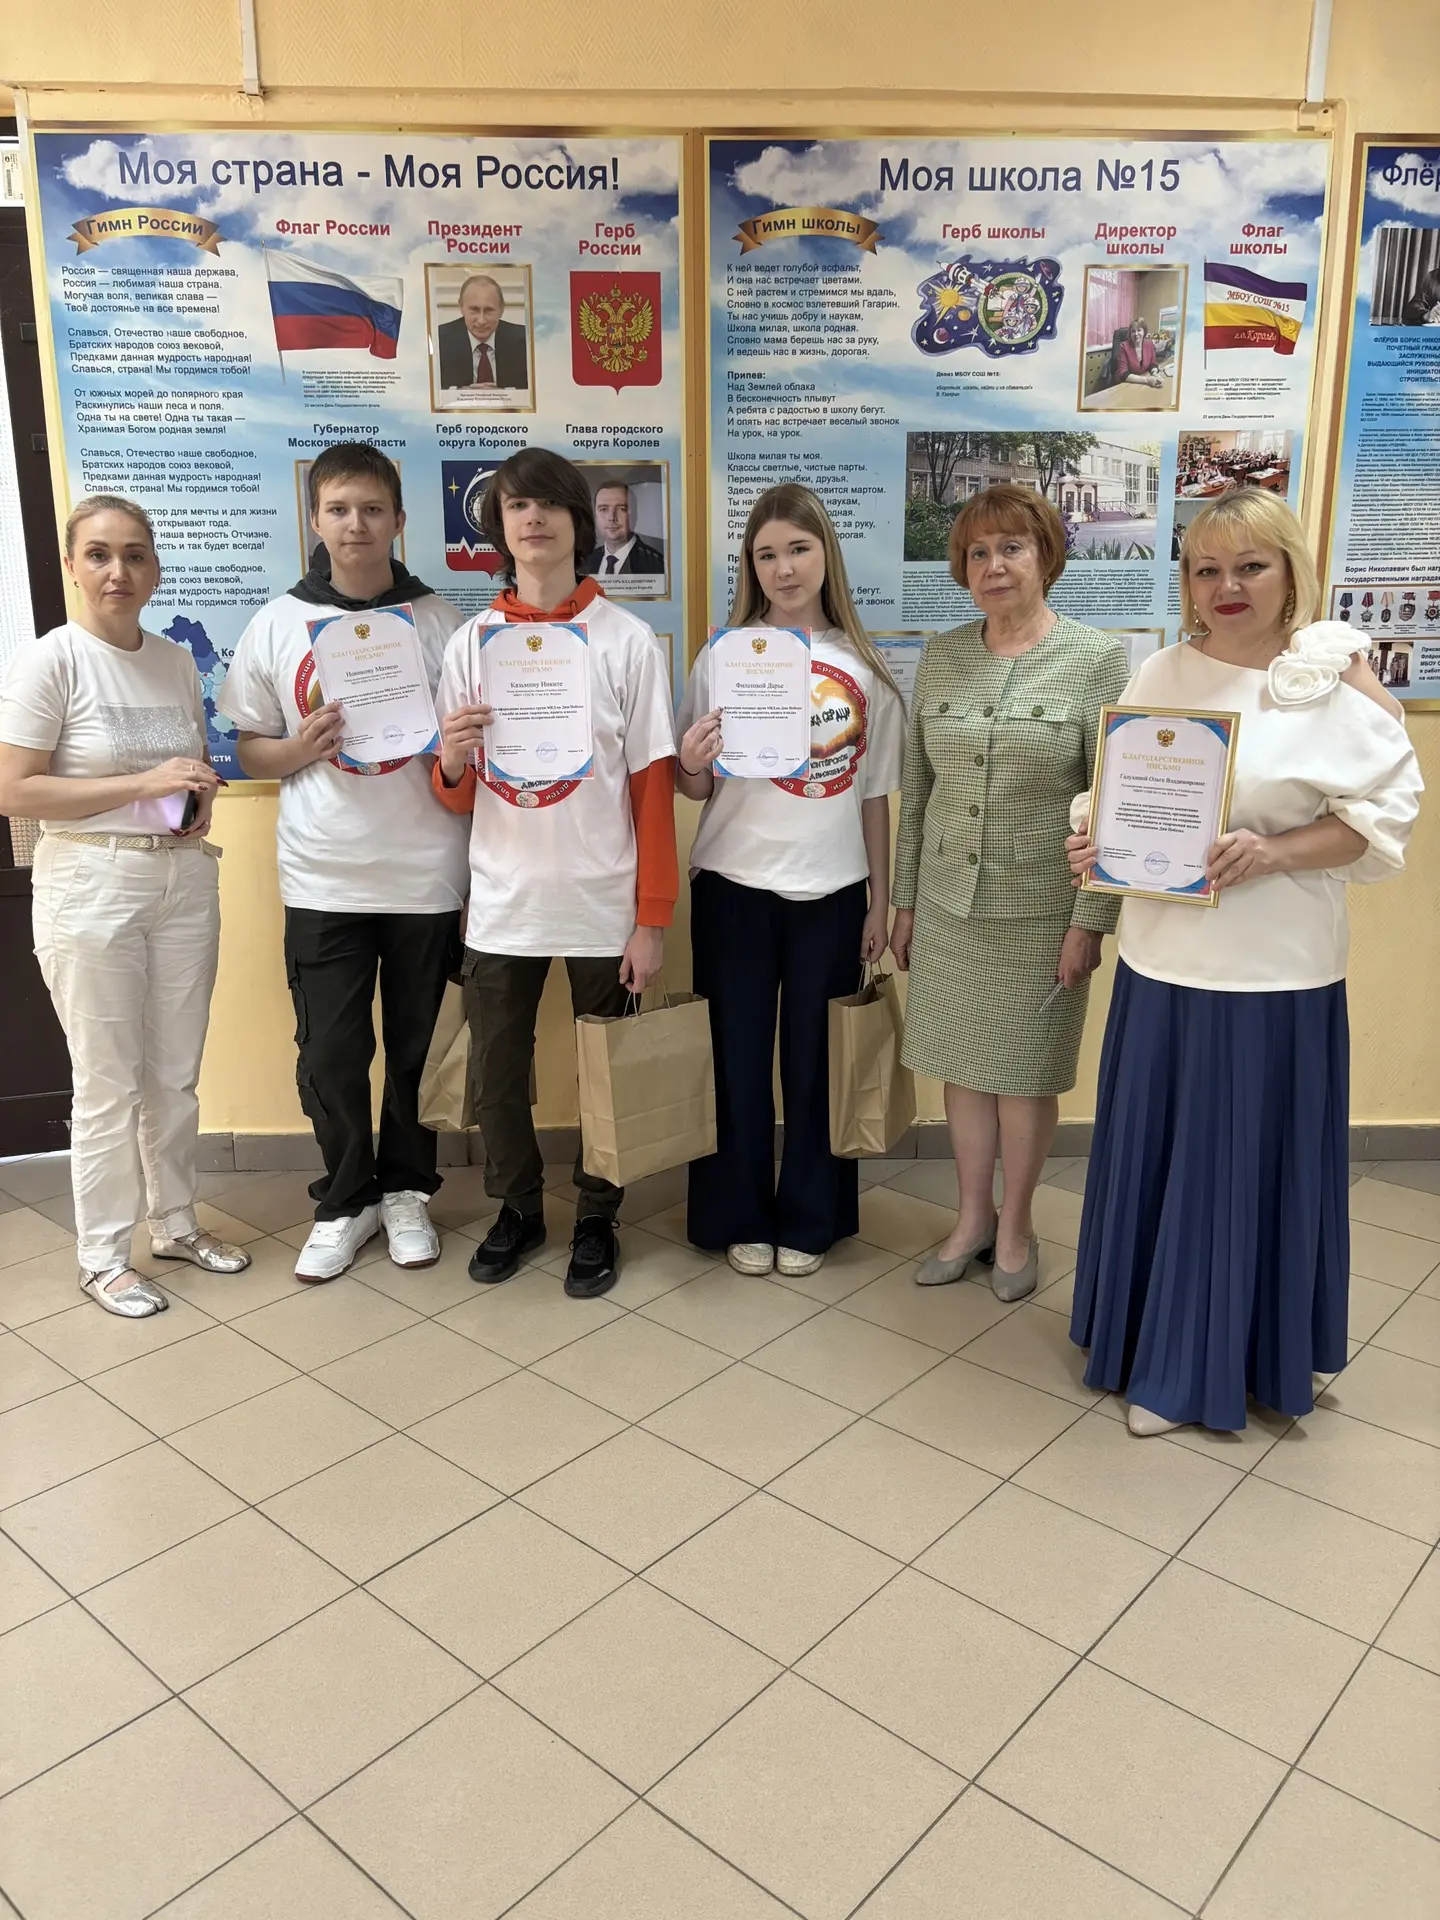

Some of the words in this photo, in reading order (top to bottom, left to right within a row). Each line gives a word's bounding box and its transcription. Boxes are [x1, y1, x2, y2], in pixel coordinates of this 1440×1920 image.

[118, 151, 197, 185] Моя
[211, 159, 344, 194] страна
[384, 154, 461, 189] Моя
[477, 154, 619, 191] Россия!
[879, 158, 954, 192] Моя
[968, 166, 1082, 192] школа
[1096, 158, 1181, 192] №15
[87, 215, 132, 237] Гимн
[138, 215, 203, 236] России
[276, 219, 321, 235] Флаг
[325, 219, 390, 236] России
[428, 220, 523, 239] Президент
[595, 222, 635, 241] Герб
[752, 218, 796, 235] Гимн
[802, 220, 861, 235] школы
[942, 223, 982, 242] Герб
[987, 227, 1045, 239] школы
[1094, 222, 1177, 240] Директор
[1241, 223, 1284, 238] Флаг
[446, 238, 510, 254] России
[579, 240, 641, 256] России
[1106, 243, 1164, 255] школы
[1230, 243, 1287, 255] школы
[61, 265, 96, 275] Россия
[111, 268, 164, 277] священная
[166, 268, 192, 276] наша
[194, 268, 239, 278] держава,
[726, 263, 733, 272] К
[735, 263, 752, 273] ней
[754, 265, 781, 274] ведет
[782, 263, 819, 275] голубой
[821, 263, 862, 274] асфальт,
[62, 278, 97, 288] Россия
[112, 278, 156, 288] любимая
[158, 280, 184, 289] наша
[186, 281, 222, 291] страна.
[727, 275, 734, 285] И
[736, 277, 753, 285] она
[755, 277, 772, 285] нас
[774, 276, 820, 286] встречает
[821, 276, 862, 286] цветами.
[64, 290, 104, 302] Могучая
[106, 292, 132, 302] воля,
[134, 293, 174, 301] великая
[175, 293, 204, 301] слава
[726, 287, 734, 297] С
[736, 287, 753, 297] ней
[755, 289, 788, 298] растем
[798, 289, 848, 299] стремимся
[850, 289, 865, 297] мы
[866, 289, 897, 298] вдаль,
[1227, 290, 1252, 303] МБОУ
[66, 303, 88, 312] Твоё
[90, 305, 141, 314] достоянье
[142, 305, 155, 313] на
[157, 305, 174, 313] все
[176, 304, 220, 315] времена!
[726, 299, 762, 309] Словно
[763, 301, 769, 309] в
[771, 301, 804, 309] космос
[805, 299, 860, 309] взлетевший
[862, 299, 900, 310] Гагарин.
[67, 327, 112, 338] Славься,
[113, 327, 164, 338] Отечество
[166, 327, 192, 338] наше
[194, 328, 247, 340] свободное,
[69, 339, 113, 351] Братских
[114, 342, 155, 351] народов
[156, 342, 181, 350] союз
[182, 341, 224, 351] вековой,
[70, 351, 118, 363] Предками
[120, 354, 155, 363] данная
[157, 354, 202, 364] мудрость
[204, 353, 252, 364] народная!
[71, 363, 115, 375] Славься,
[117, 365, 153, 376] страна!
[155, 364, 172, 374] Мы
[174, 366, 218, 376] гордимся
[220, 365, 251, 375] тобой!
[727, 370, 766, 381] Припев:
[727, 382, 745, 392] Над
[747, 382, 782, 391] Землей
[784, 382, 816, 391] облака
[74, 388, 87, 398] От
[89, 390, 123, 398] южных
[124, 389, 155, 400] морей
[156, 390, 169, 399] до
[171, 391, 220, 400] полярного
[222, 391, 244, 401] края
[727, 394, 734, 403] В
[736, 393, 802, 403] бесконечность
[804, 395, 836, 405] плывут
[75, 400, 136, 412] Раскинулись
[137, 402, 163, 410] наши
[165, 402, 188, 410] леса
[199, 403, 224, 411] поля.
[313, 423, 380, 436] Губернатор
[436, 423, 462, 436] Герб
[465, 425, 529, 436] городского
[565, 423, 598, 434] Глава
[601, 426, 664, 436] городского
[727, 428, 740, 438] На
[741, 430, 765, 440] урок,
[780, 430, 803, 439] урок.
[438, 439, 476, 450] округа
[479, 437, 527, 449] Королев
[572, 439, 610, 450] округа
[612, 437, 660, 450] Королев
